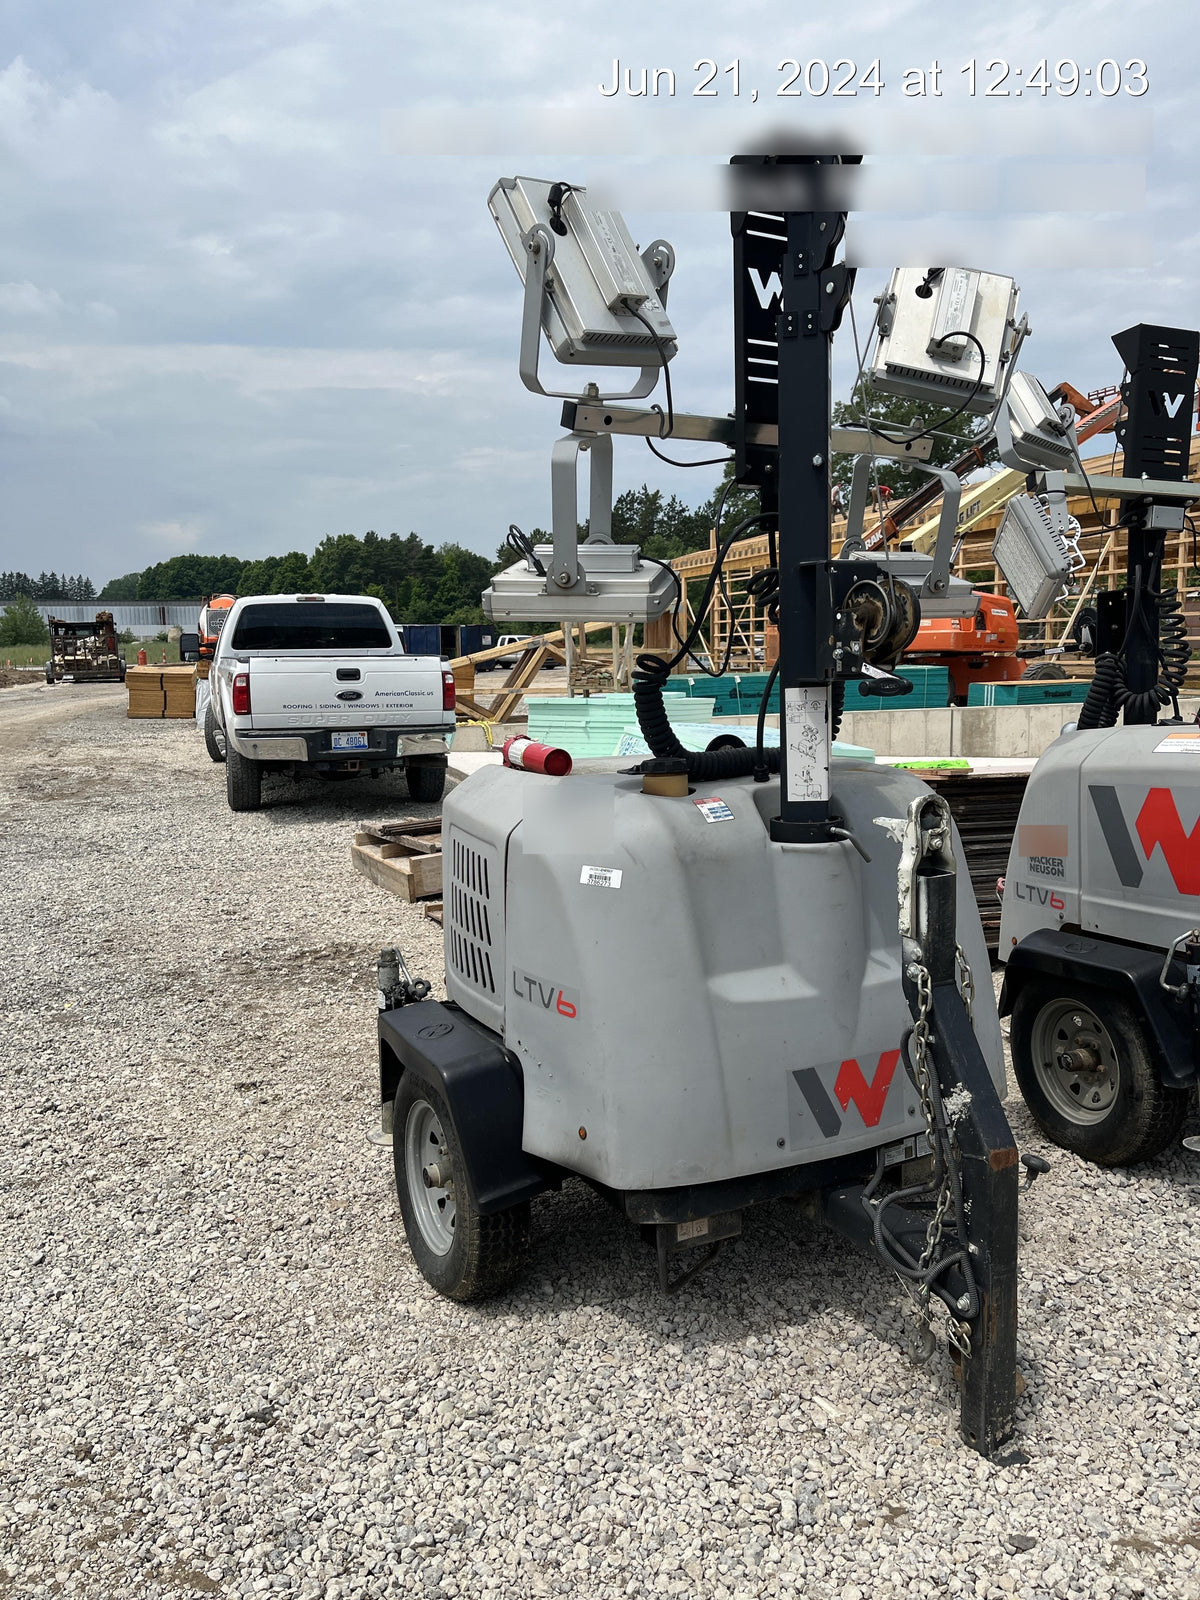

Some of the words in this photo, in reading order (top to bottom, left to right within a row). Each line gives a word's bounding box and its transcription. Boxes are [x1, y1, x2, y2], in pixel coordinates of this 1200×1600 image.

[966, 500, 981, 519] LIFT
[865, 528, 884, 551] RAK
[288, 715, 351, 725] SUPER
[363, 713, 413, 724] DUTY
[1029, 856, 1064, 868] WACKER
[1029, 862, 1065, 878] NEUSON
[1016, 882, 1065, 910] LTV6
[513, 971, 577, 1018] LTV6
